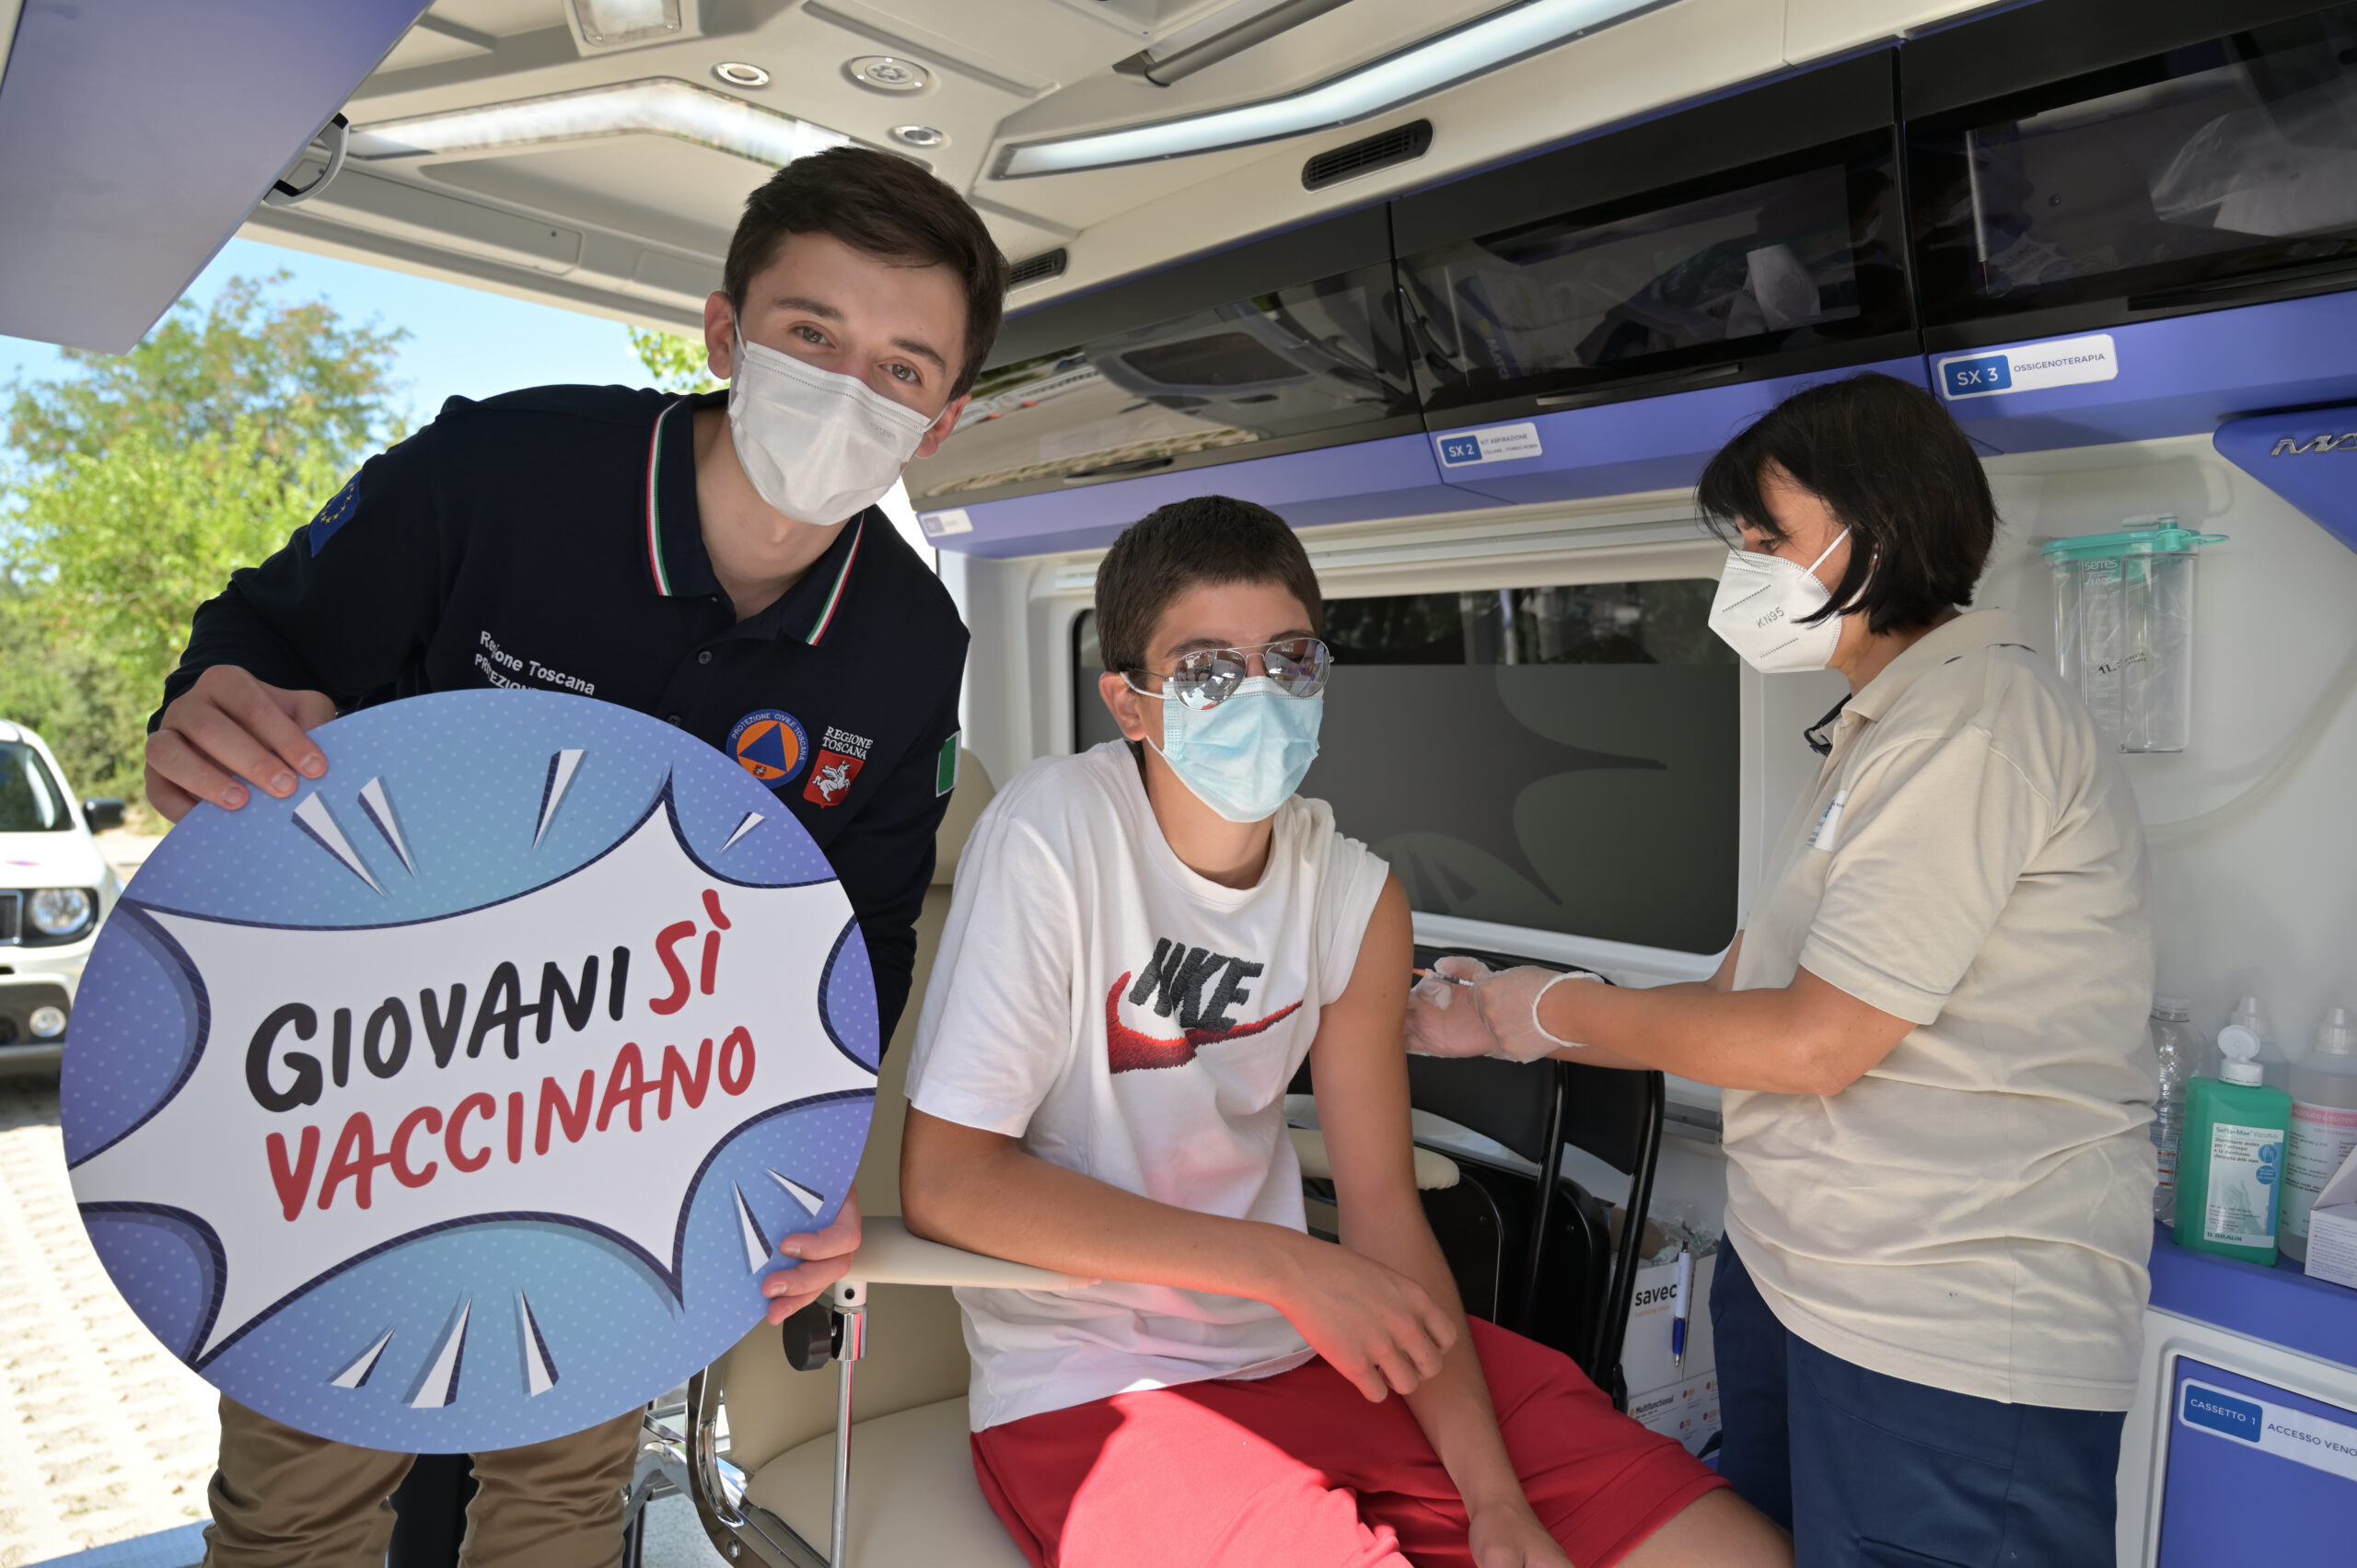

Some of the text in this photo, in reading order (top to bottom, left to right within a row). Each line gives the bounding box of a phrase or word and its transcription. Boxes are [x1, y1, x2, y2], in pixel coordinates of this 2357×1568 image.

[1956, 353, 2106, 386] SX 3 OSSIGENOTERAPIA
[1448, 445, 1465, 458] SX
[1466, 443, 1475, 456] 2
[2084, 559, 2119, 571] serres
[1756, 606, 1785, 629] KN95
[528, 660, 596, 696] Toscana
[731, 713, 805, 761] PROTEZIONE CIVILE TOSCANA
[822, 737, 866, 760] TOSCANA
[825, 726, 874, 749] REGIONE
[245, 945, 630, 1112] GIOVANI
[266, 1026, 755, 1222] VACCINANO
[2190, 1399, 2247, 1422] CASSETTO
[2251, 1417, 2256, 1425] 1
[2268, 1423, 2321, 1446] ACCESSO
